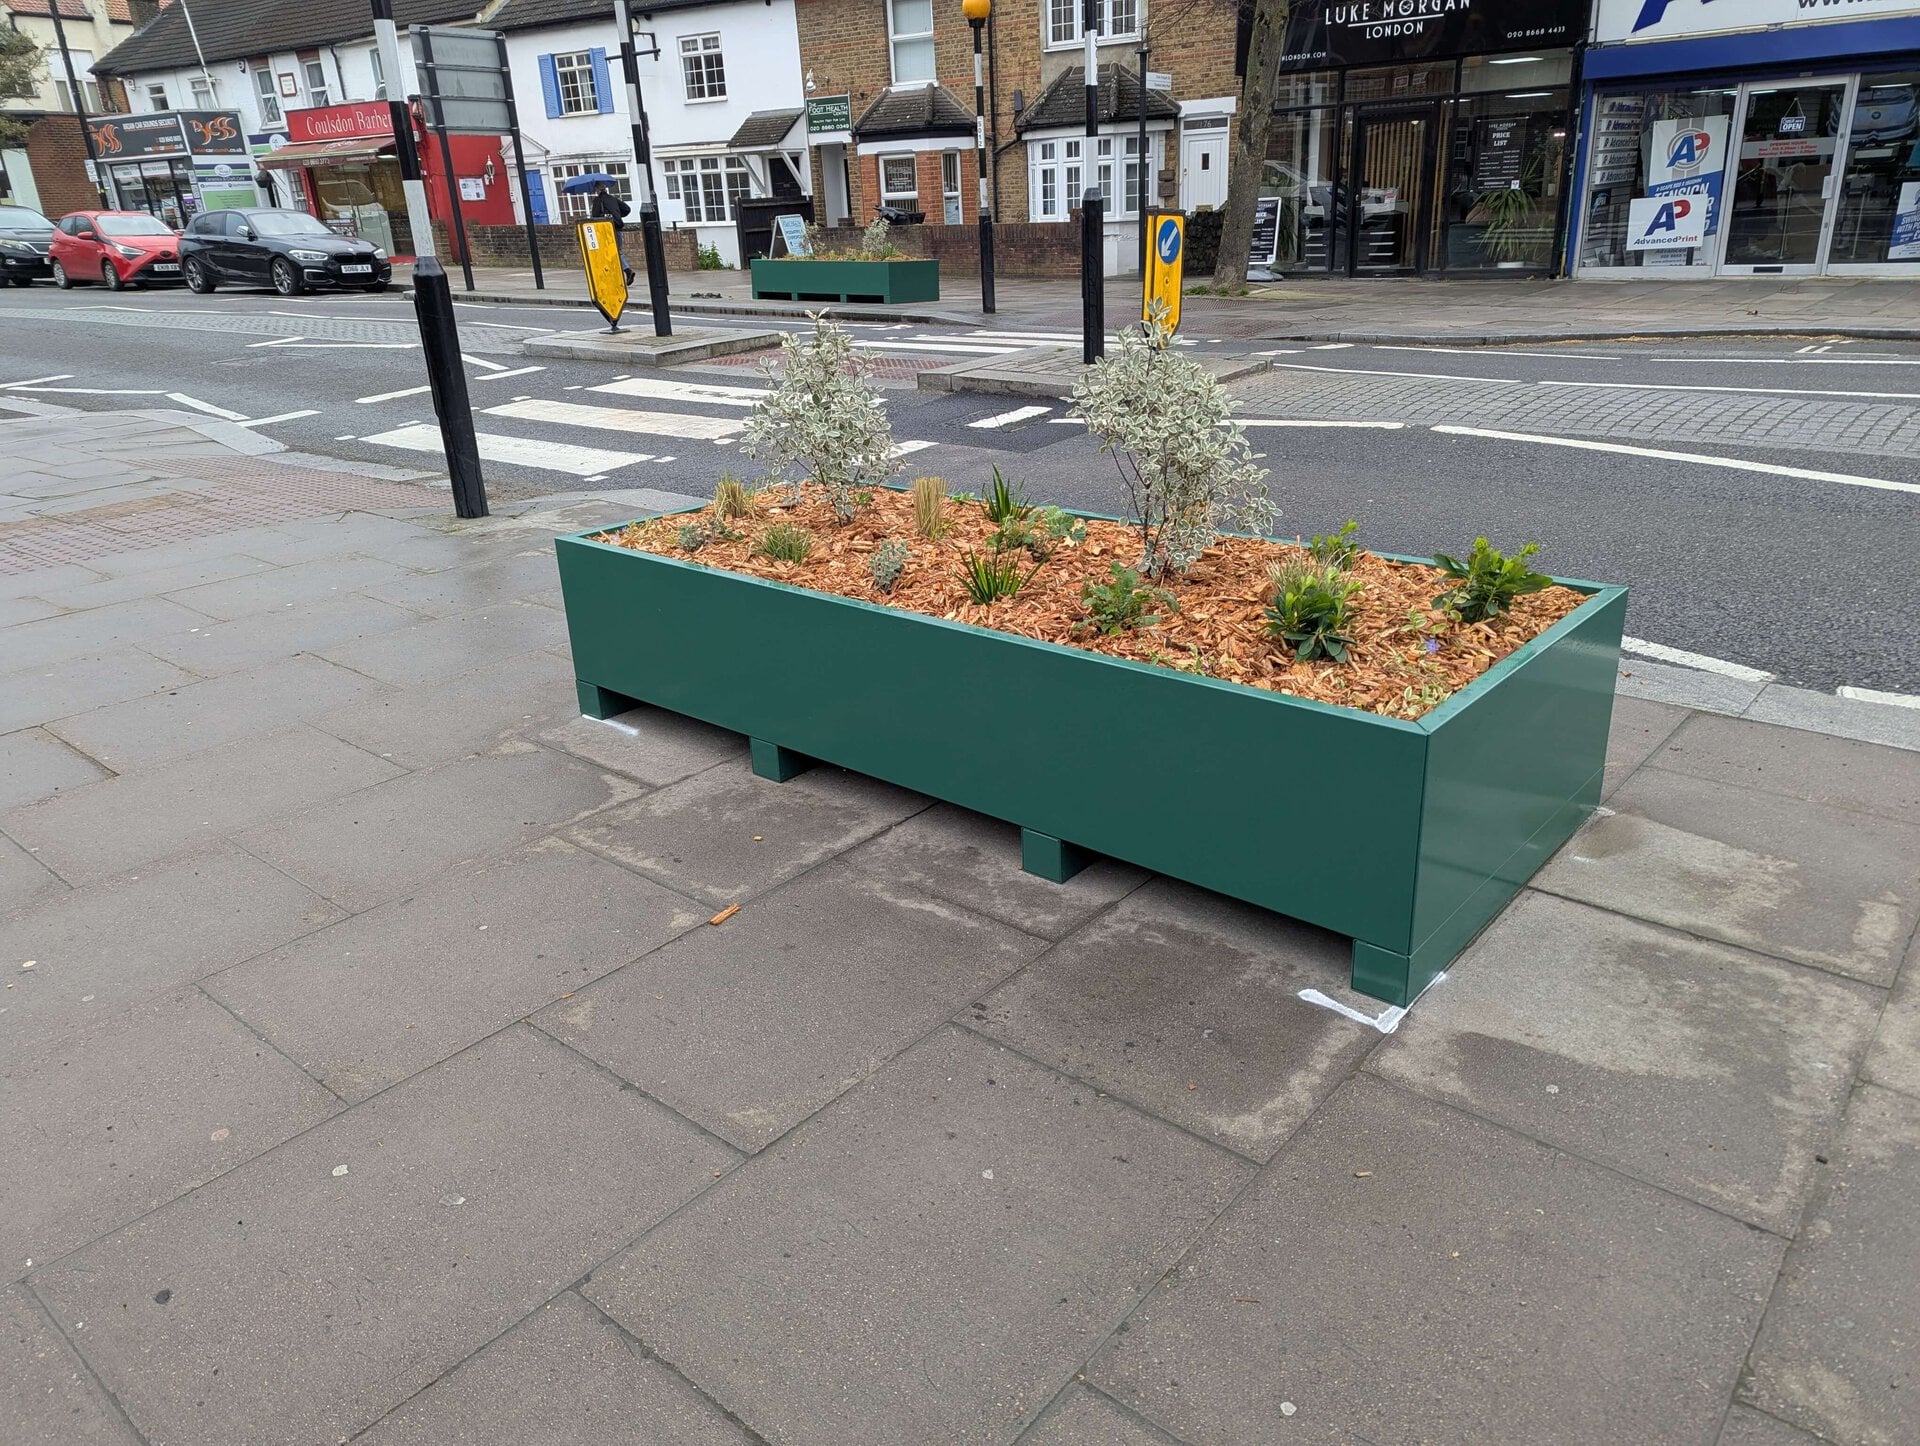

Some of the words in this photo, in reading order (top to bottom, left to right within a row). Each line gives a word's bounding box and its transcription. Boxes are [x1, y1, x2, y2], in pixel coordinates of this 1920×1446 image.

[1325, 3, 1370, 25] LUKE
[1383, 0, 1470, 18] MORGAN
[1366, 21, 1423, 39] LONDON
[825, 104, 848, 112] HEALTH
[306, 115, 355, 136] Coulsdon
[1782, 123, 1802, 131] OPEN
[1492, 131, 1511, 139] PRICE
[587, 226, 596, 249] B10
